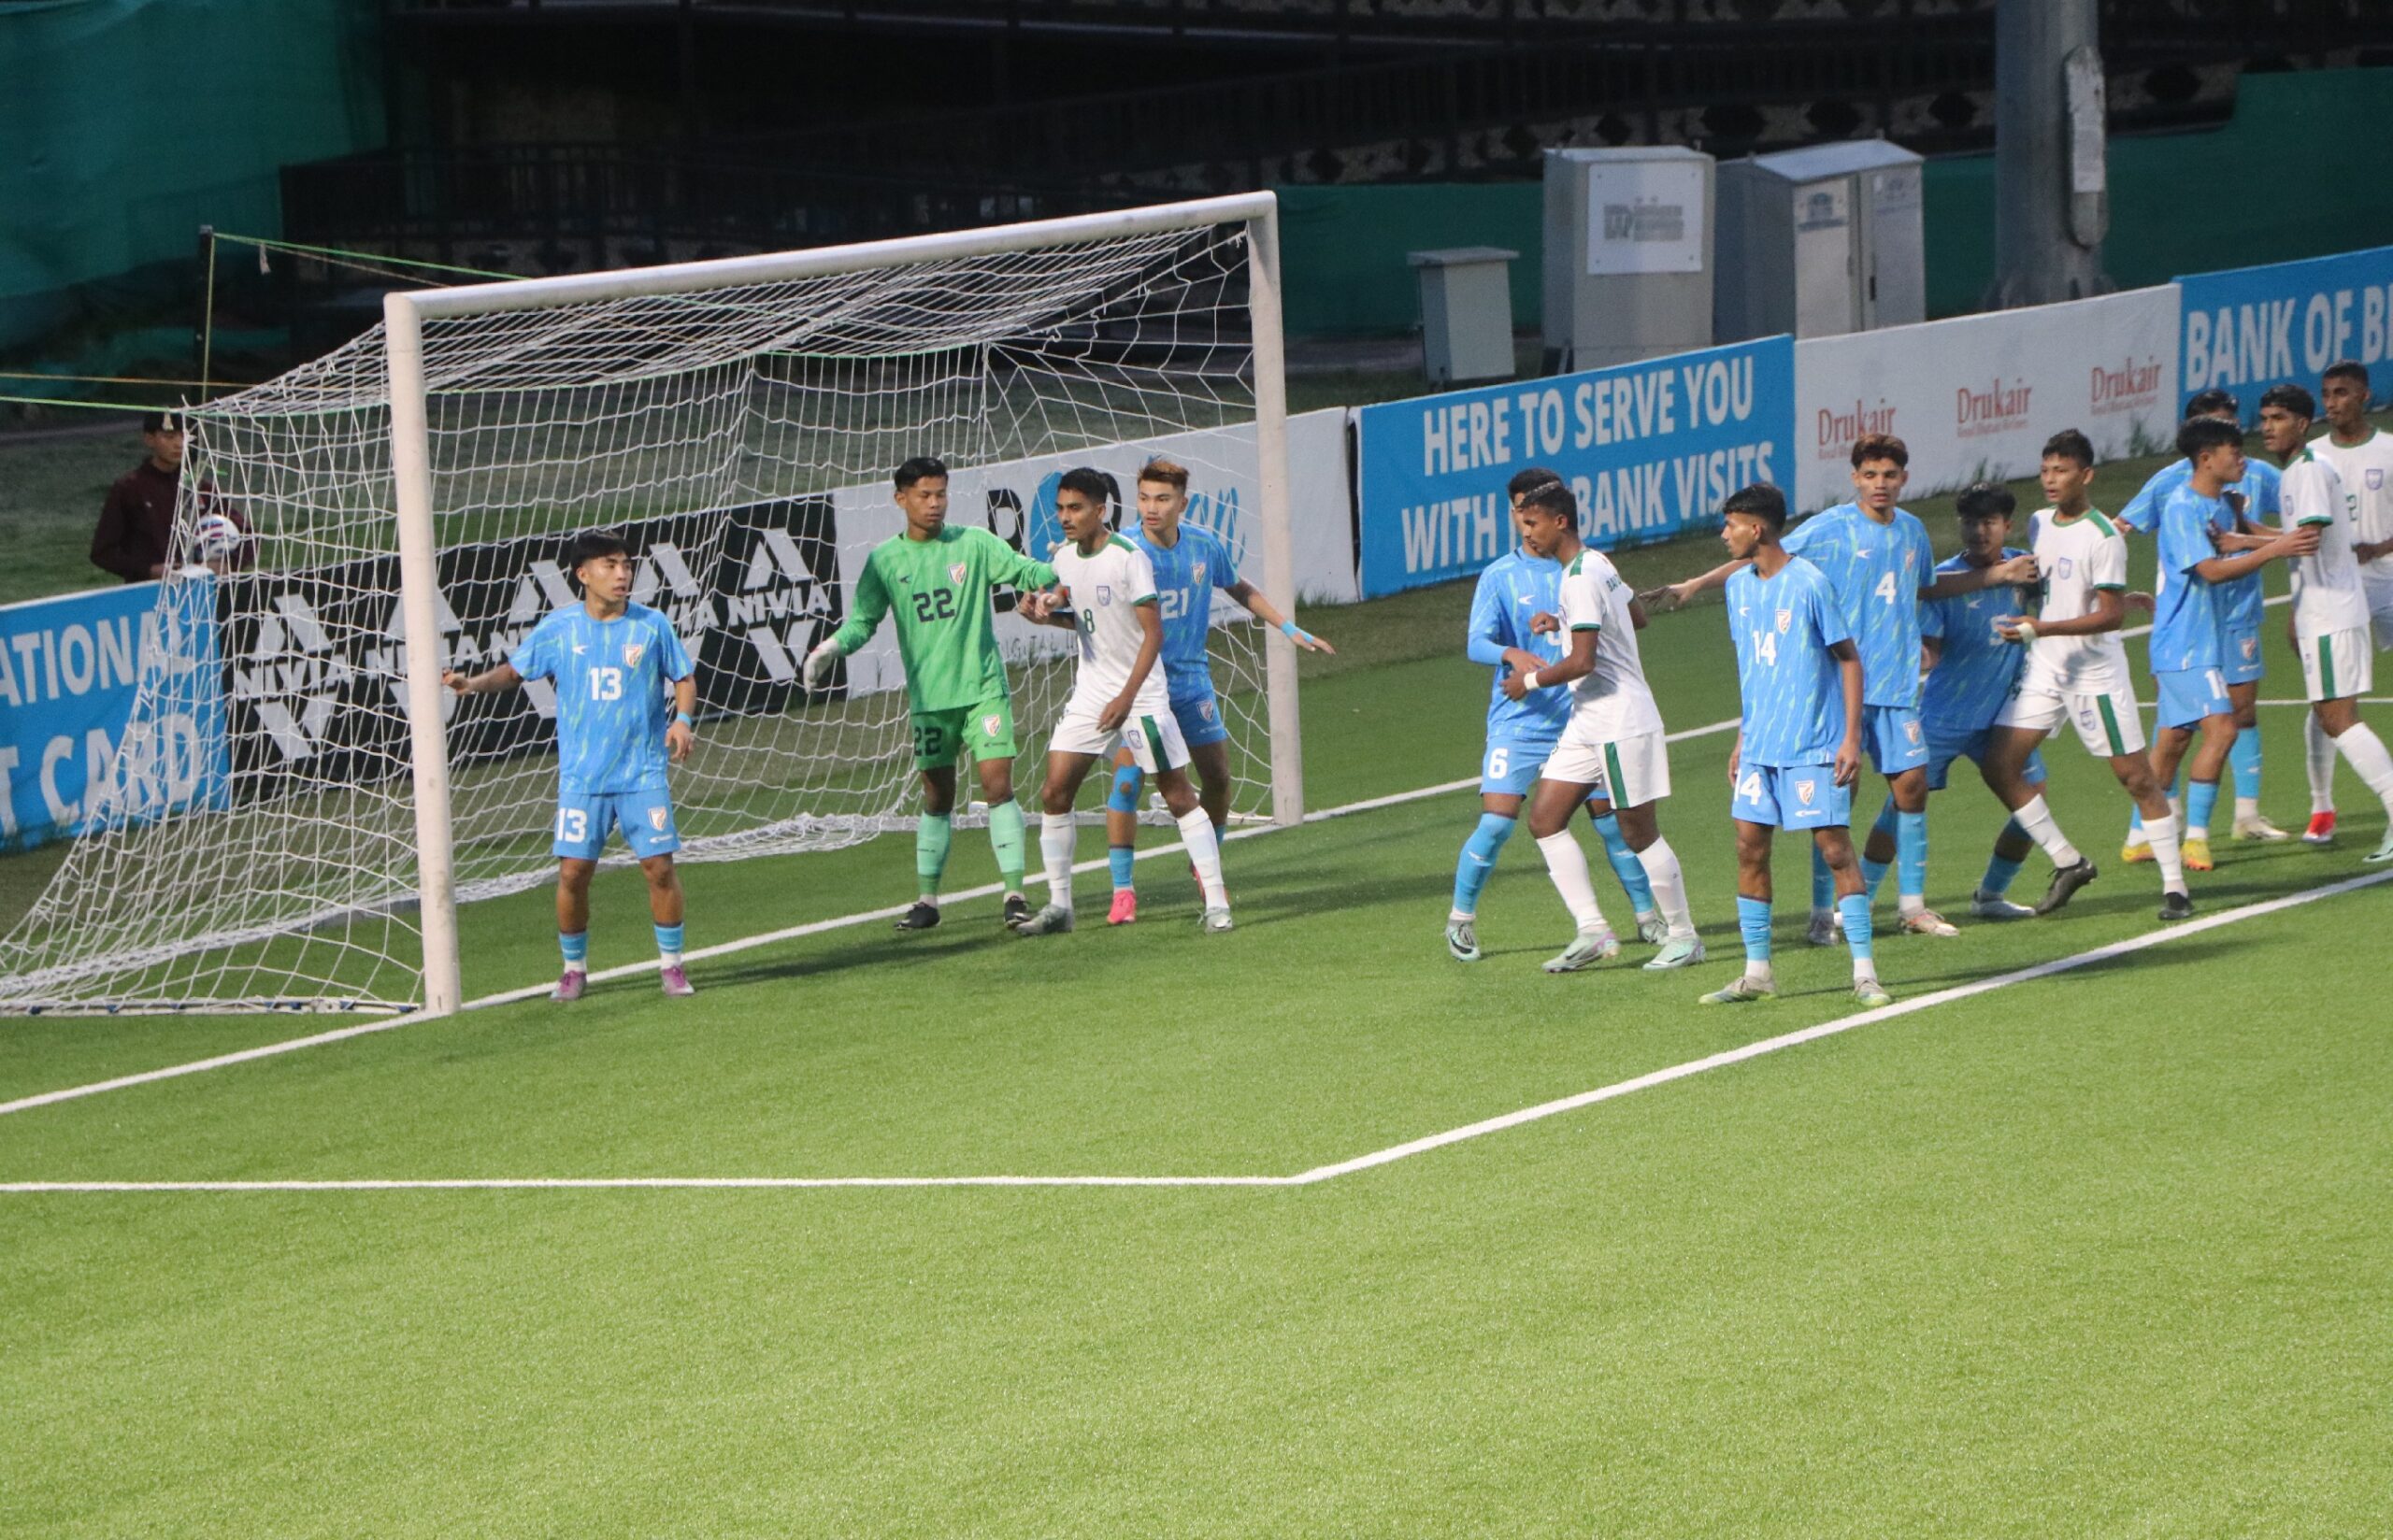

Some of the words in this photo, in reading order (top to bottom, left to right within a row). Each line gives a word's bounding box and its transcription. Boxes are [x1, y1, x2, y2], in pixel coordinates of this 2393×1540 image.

[2185, 298, 2296, 392] BANK
[2305, 289, 2354, 374] OF
[2362, 283, 2393, 365] B
[1956, 378, 2032, 424] Drukair
[2091, 356, 2162, 405] Drukair
[1425, 397, 1511, 477] HERE
[1519, 388, 1564, 458] TO
[1575, 369, 1674, 449] SERVE
[1684, 356, 1753, 429] YOU
[1818, 399, 1897, 446] Drukair
[1571, 461, 1667, 541] BANK
[1674, 441, 1774, 520] VISITS
[1402, 492, 1497, 574] WITH
[727, 584, 833, 627] NIVIA
[912, 588, 955, 623] 22
[1159, 587, 1190, 621] 21
[1874, 570, 1897, 606] 4
[1083, 608, 1096, 635] 8
[365, 635, 483, 680] NIIA
[1753, 630, 1777, 666] 14
[235, 654, 355, 701] NIVIA
[589, 666, 622, 701] 13
[40, 713, 203, 827] CARD
[1488, 748, 1509, 779] 6
[1734, 768, 1762, 806] 14
[557, 807, 588, 843] 13
